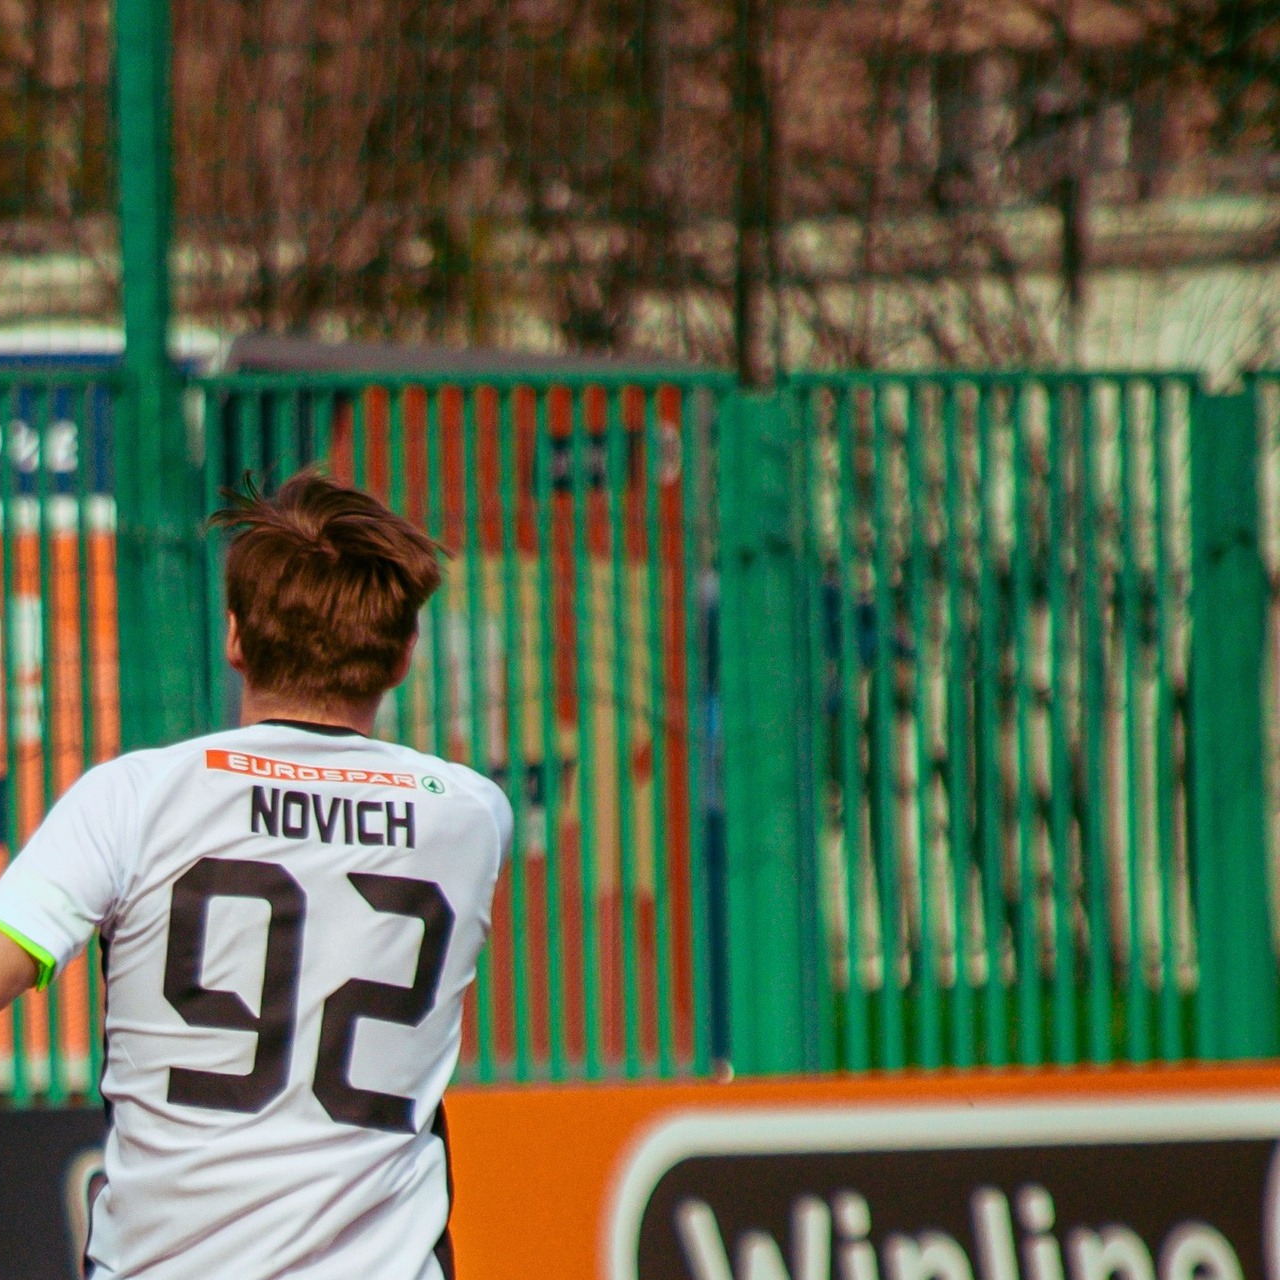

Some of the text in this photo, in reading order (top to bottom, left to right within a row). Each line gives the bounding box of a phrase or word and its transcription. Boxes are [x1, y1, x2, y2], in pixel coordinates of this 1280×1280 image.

[227, 754, 417, 788] EUROSPAR
[251, 785, 416, 849] NOVICH
[163, 856, 456, 1135] 92
